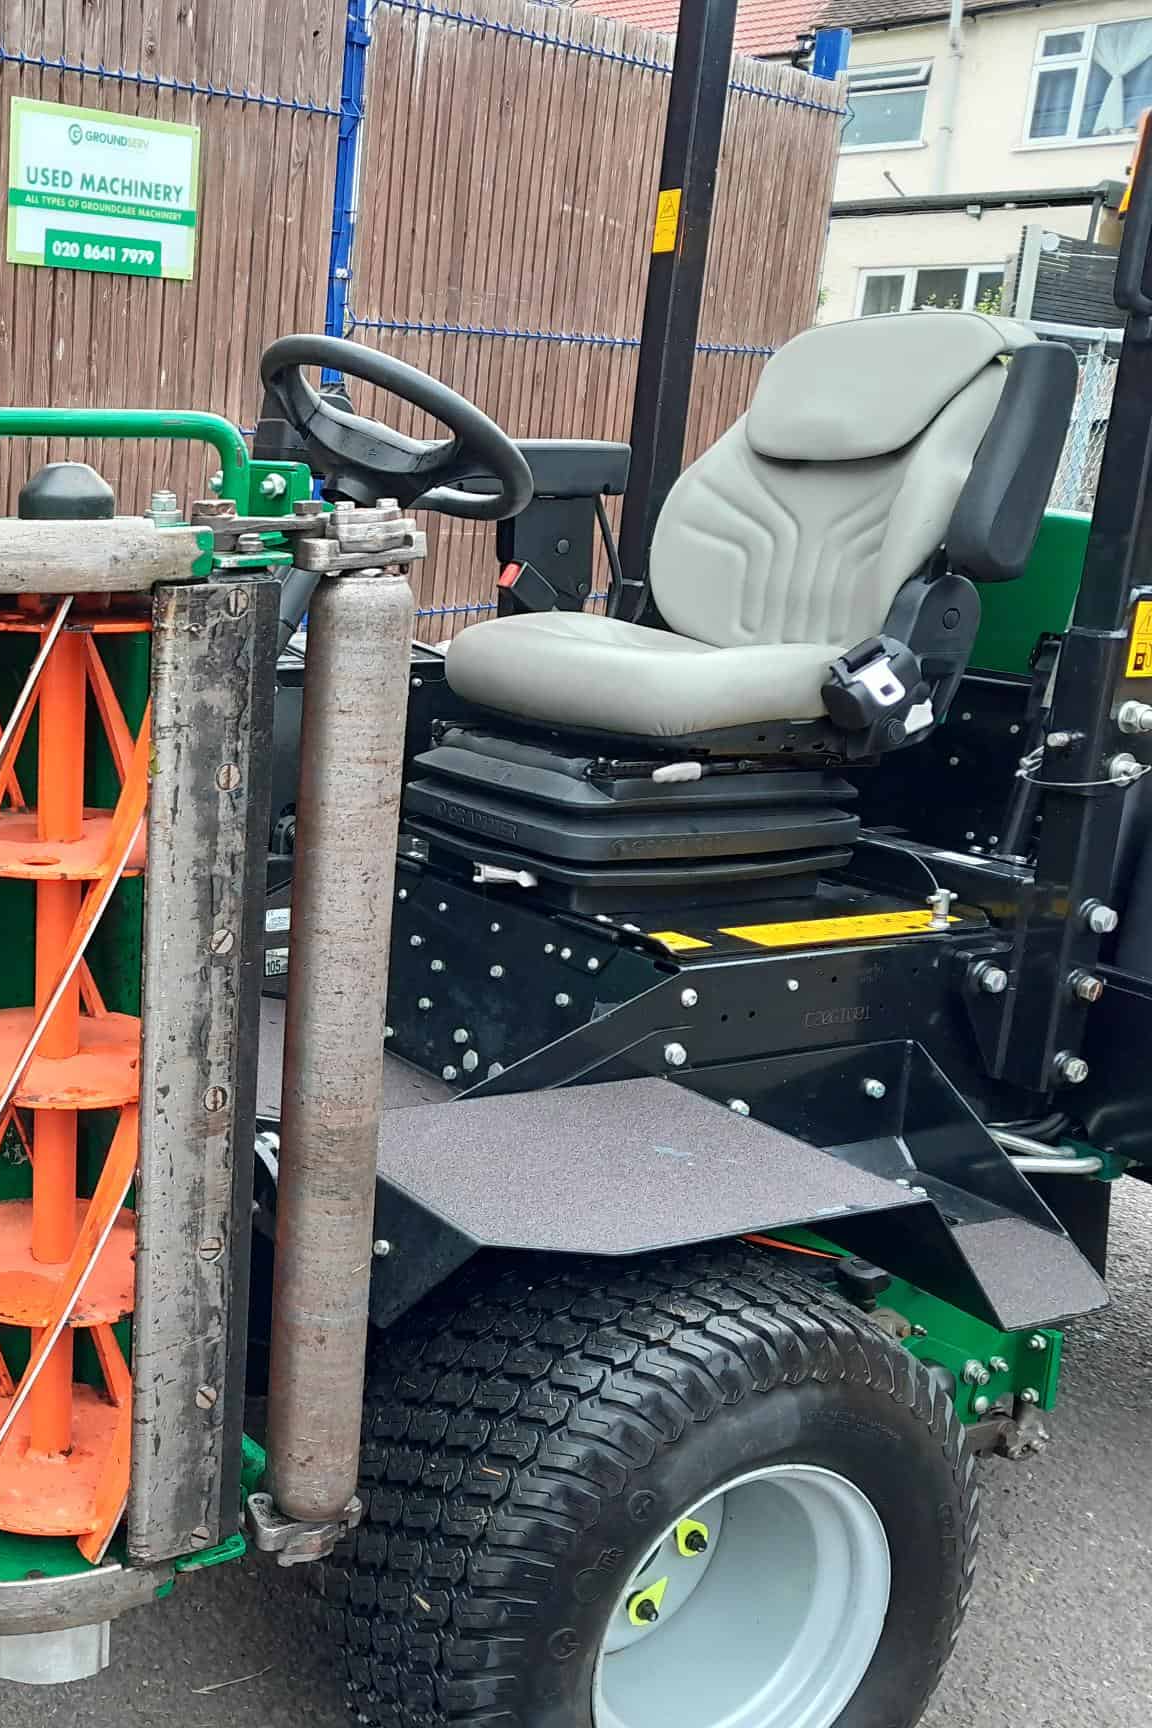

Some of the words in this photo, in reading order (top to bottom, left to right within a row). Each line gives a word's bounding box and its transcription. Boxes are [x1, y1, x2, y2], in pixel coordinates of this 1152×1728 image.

[26, 165, 73, 189] USED
[80, 172, 183, 203] MACHINERY
[25, 193, 39, 204] ALL
[42, 195, 66, 207] TYPES
[68, 198, 80, 208] OF
[81, 200, 136, 216] GROUNDCARE
[138, 207, 182, 221] MACHINERY
[52, 240, 80, 258] 020
[83, 242, 116, 261] 8641
[121, 247, 155, 265] 7979
